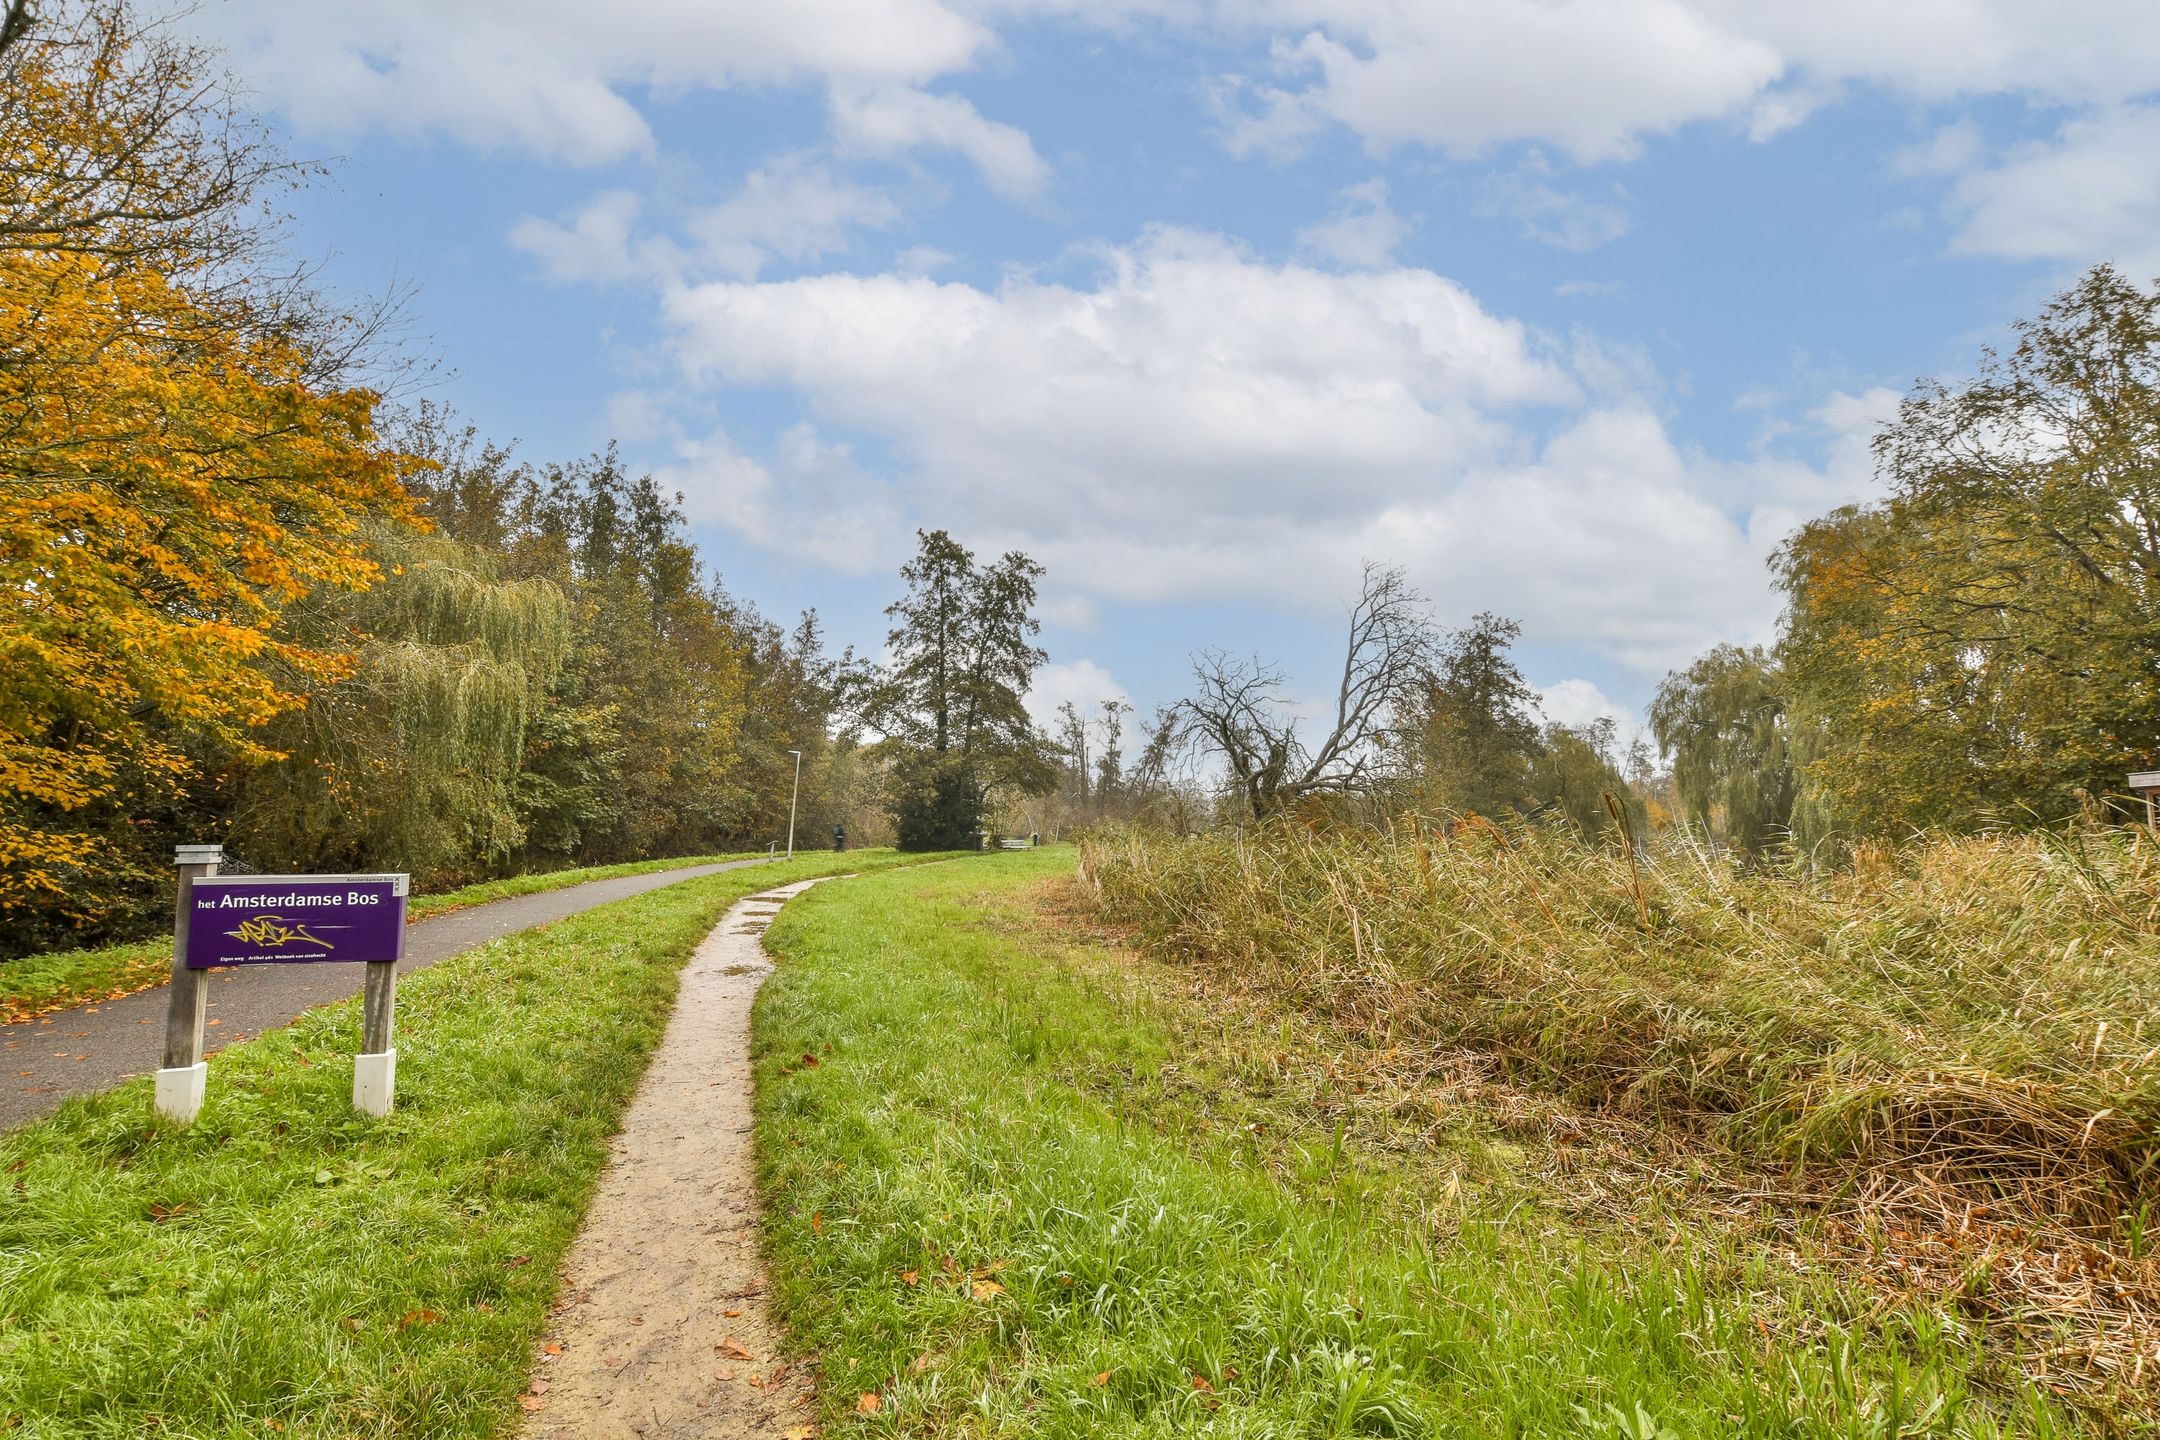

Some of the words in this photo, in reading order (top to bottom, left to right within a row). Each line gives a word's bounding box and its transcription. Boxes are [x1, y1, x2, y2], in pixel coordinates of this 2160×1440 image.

[197, 900, 216, 909] het
[219, 892, 343, 909] Amsterdamse
[347, 891, 379, 906] Bos
